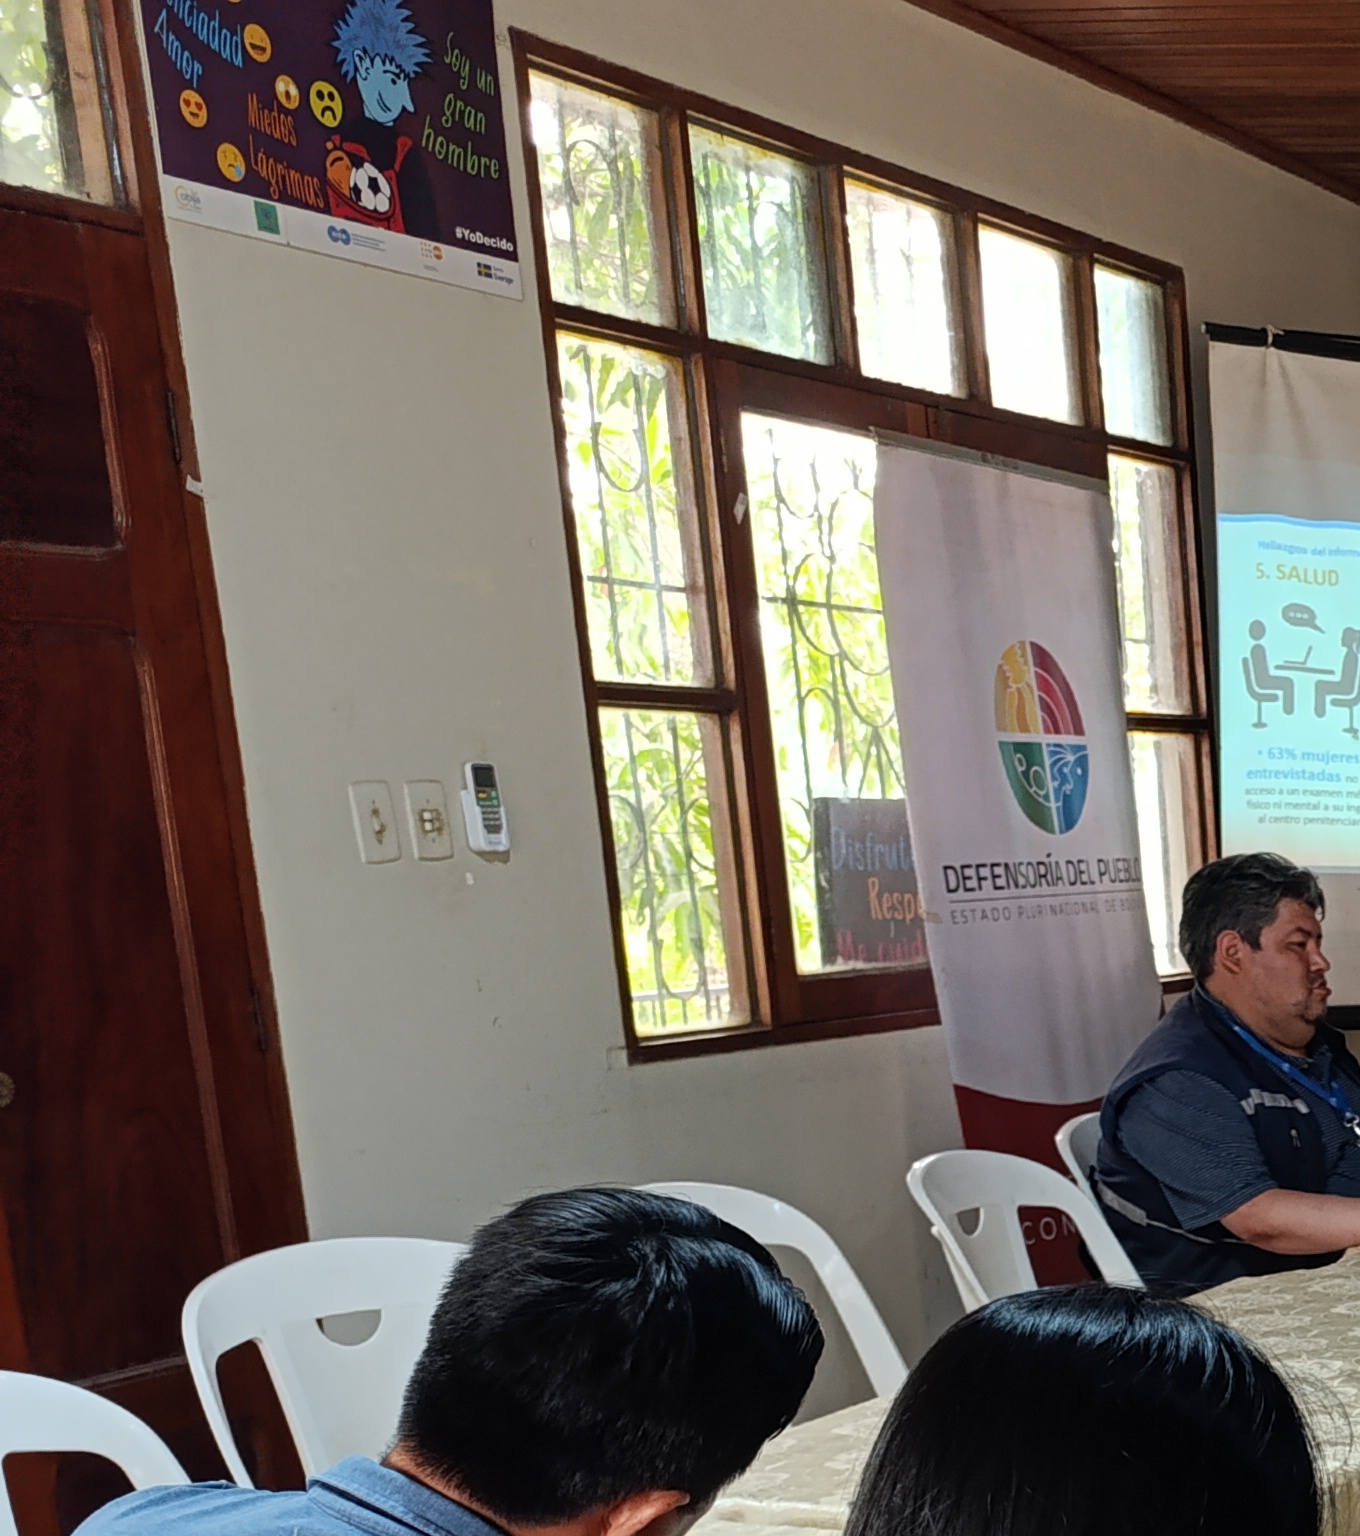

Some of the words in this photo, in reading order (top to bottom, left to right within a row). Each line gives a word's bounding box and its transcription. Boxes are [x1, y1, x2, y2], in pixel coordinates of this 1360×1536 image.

[154, 8, 203, 88] Amor
[444, 32, 470, 90] Soy
[476, 66, 496, 97] un
[248, 92, 297, 147] Miedos
[442, 93, 486, 135] gran
[421, 114, 500, 179] hombre
[249, 133, 325, 209] Lágrimas
[455, 226, 514, 252] #YoDecido
[1311, 547, 1326, 556] del
[1256, 562, 1270, 580] 5.
[1276, 563, 1340, 586] SALUD
[1267, 747, 1297, 760] 63%
[1301, 750, 1360, 765] mujeres
[1246, 767, 1341, 782] entrevistadas
[1345, 774, 1358, 783] no
[1244, 787, 1276, 796] acceso
[1278, 788, 1284, 796] a
[1286, 788, 1299, 796] un
[1302, 788, 1343, 798] examen
[1273, 800, 1282, 810] ni
[1284, 801, 1320, 811] mental
[1323, 803, 1329, 811] a
[1332, 804, 1344, 812] su
[1258, 814, 1266, 824] al
[1268, 815, 1300, 824] centro
[831, 826, 915, 872] Disfrut
[943, 852, 1065, 893] DEFENSORÍA
[1065, 858, 1096, 887] DEL
[951, 905, 1012, 925] ESTADO
[879, 928, 929, 962] cuid
